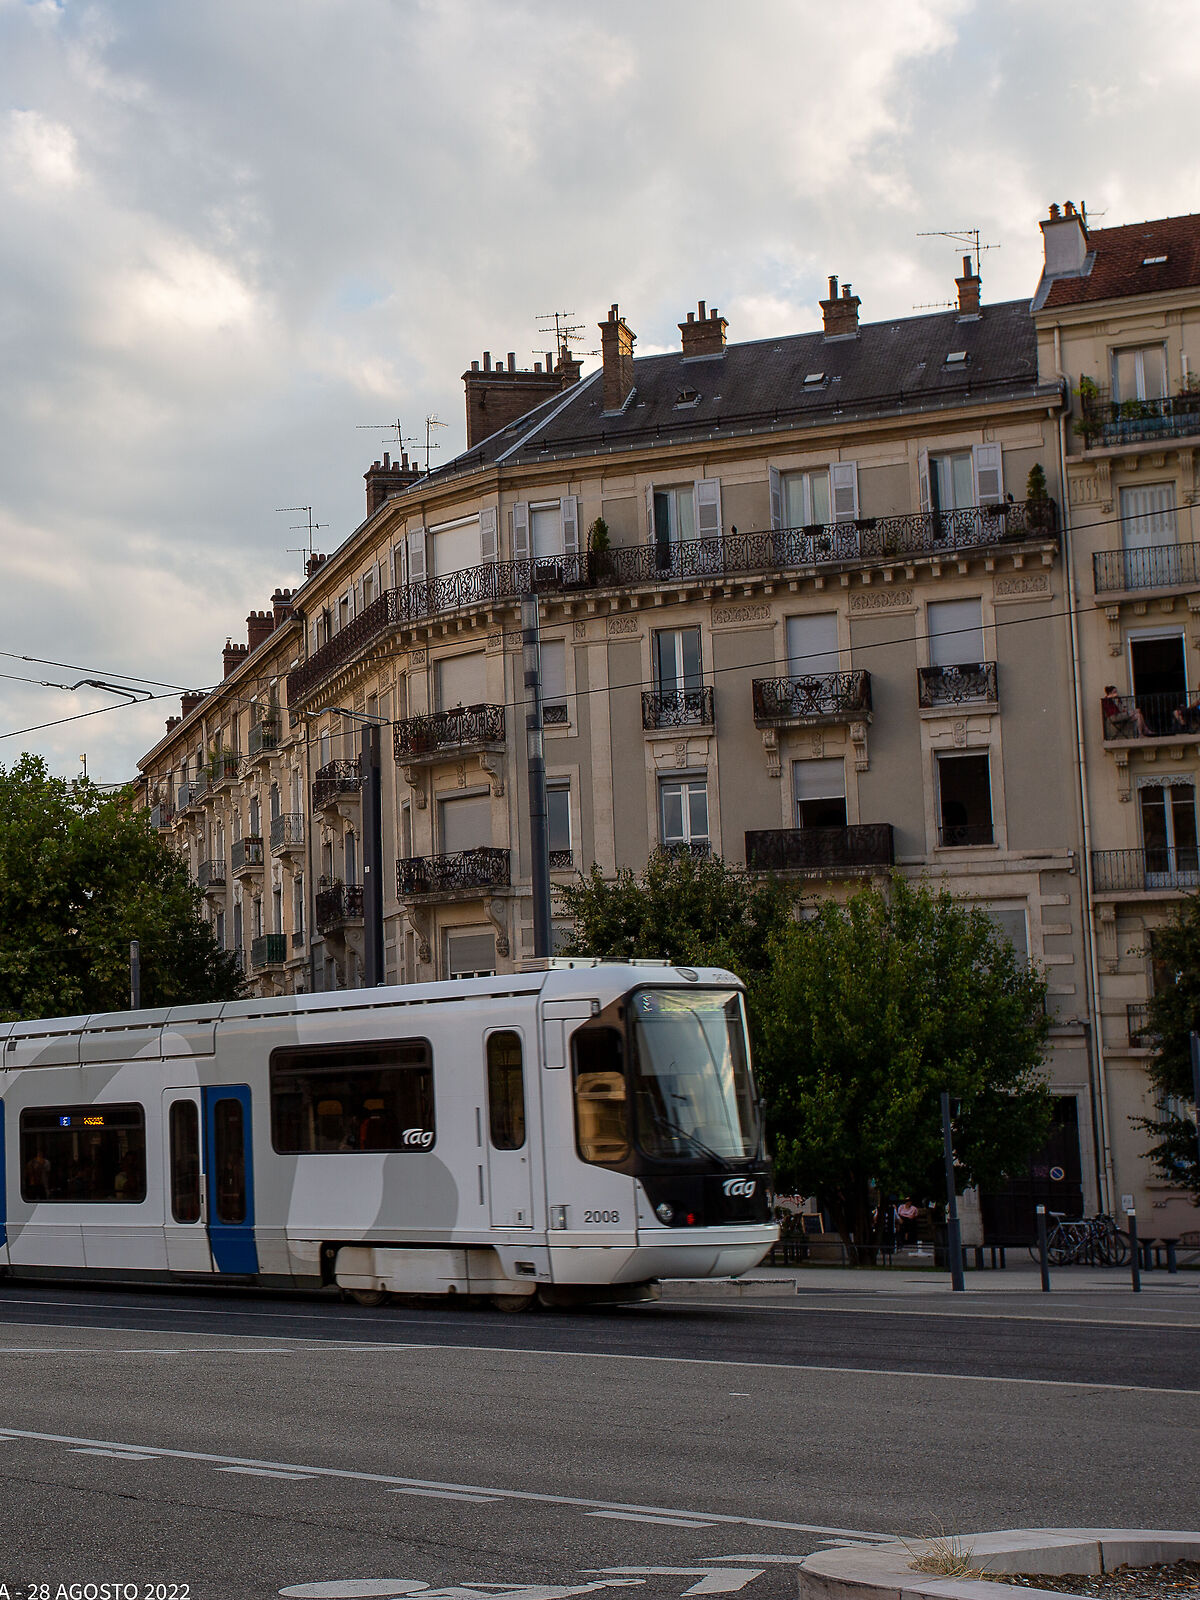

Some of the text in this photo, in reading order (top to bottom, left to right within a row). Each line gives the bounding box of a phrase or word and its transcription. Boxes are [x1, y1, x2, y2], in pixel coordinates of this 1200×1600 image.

[402, 1128, 434, 1147] Tag
[722, 1178, 756, 1198] Tag
[584, 1210, 620, 1223] 2008
